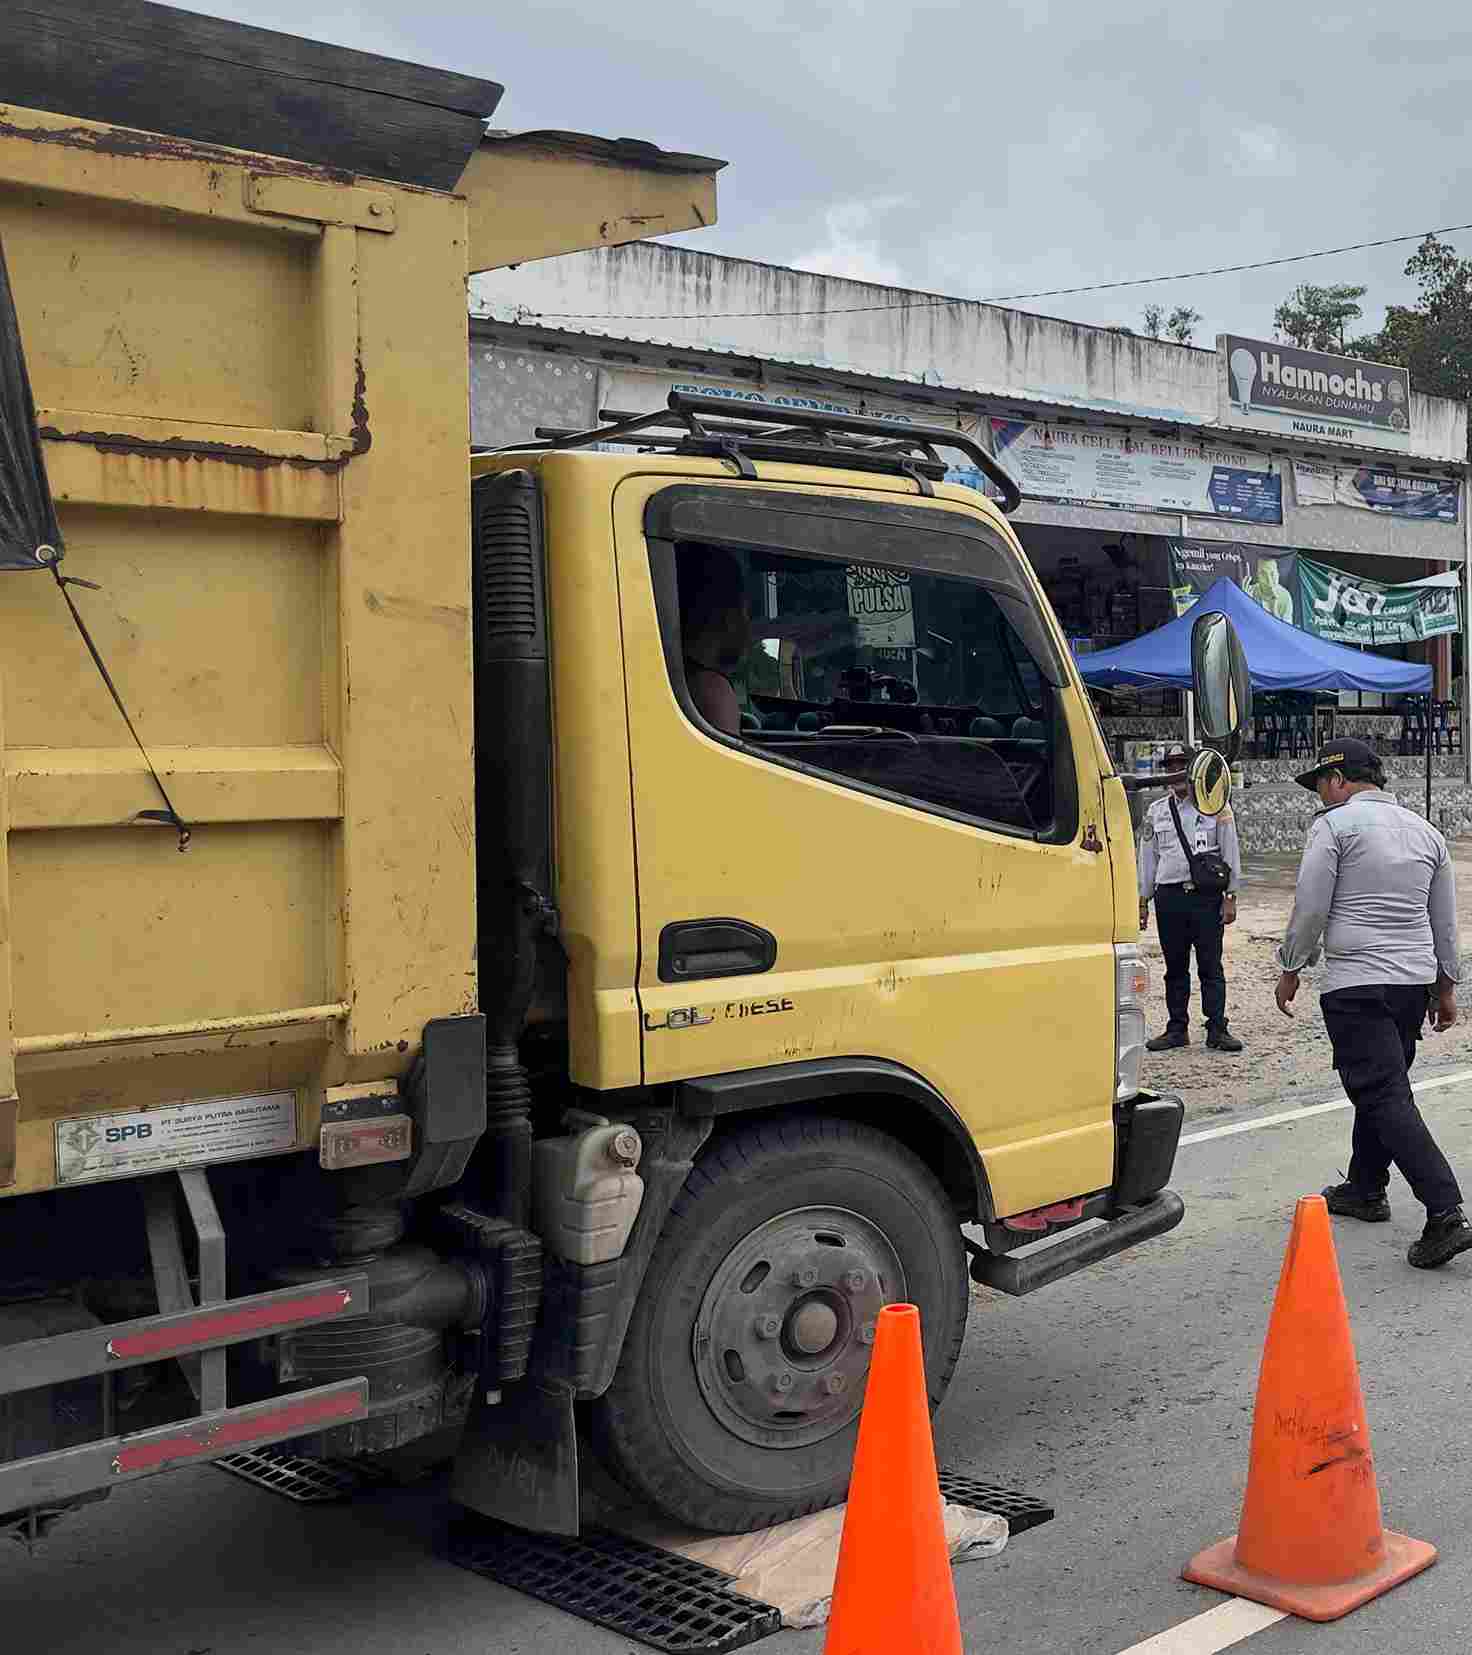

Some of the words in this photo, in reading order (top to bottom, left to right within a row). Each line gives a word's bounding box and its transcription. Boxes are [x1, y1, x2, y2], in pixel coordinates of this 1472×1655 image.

[1260, 351, 1383, 402] Hannochs
[1262, 386, 1326, 406] NYALAKAN
[1326, 399, 1376, 414] DUNIAMU
[1292, 420, 1325, 436] NAURA
[1327, 428, 1354, 441] MART
[852, 584, 906, 614] PULSA
[105, 1122, 153, 1143] SPB
